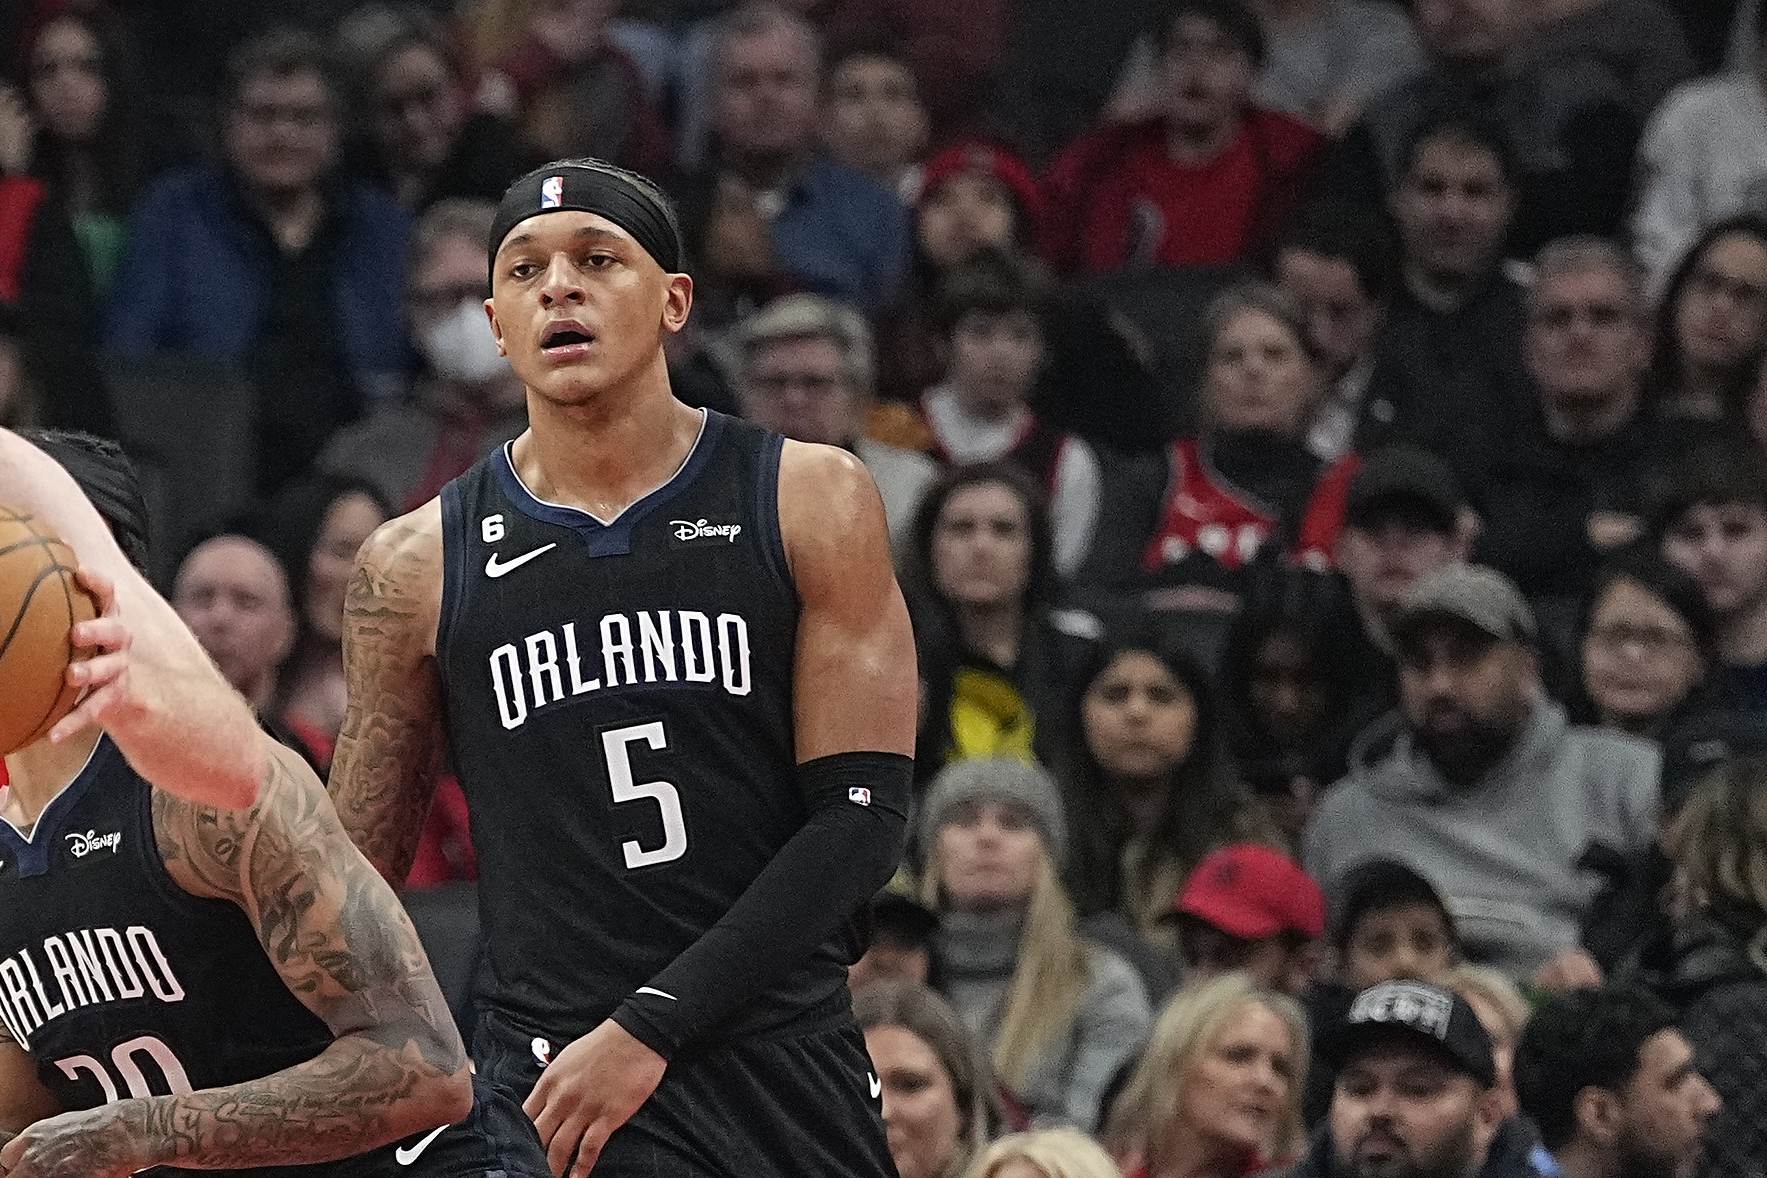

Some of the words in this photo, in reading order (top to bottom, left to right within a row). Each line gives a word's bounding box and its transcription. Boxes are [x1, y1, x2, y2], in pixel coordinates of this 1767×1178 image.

[481, 513, 505, 543] 6
[488, 610, 752, 731] ORLANDO
[600, 721, 688, 870] 5
